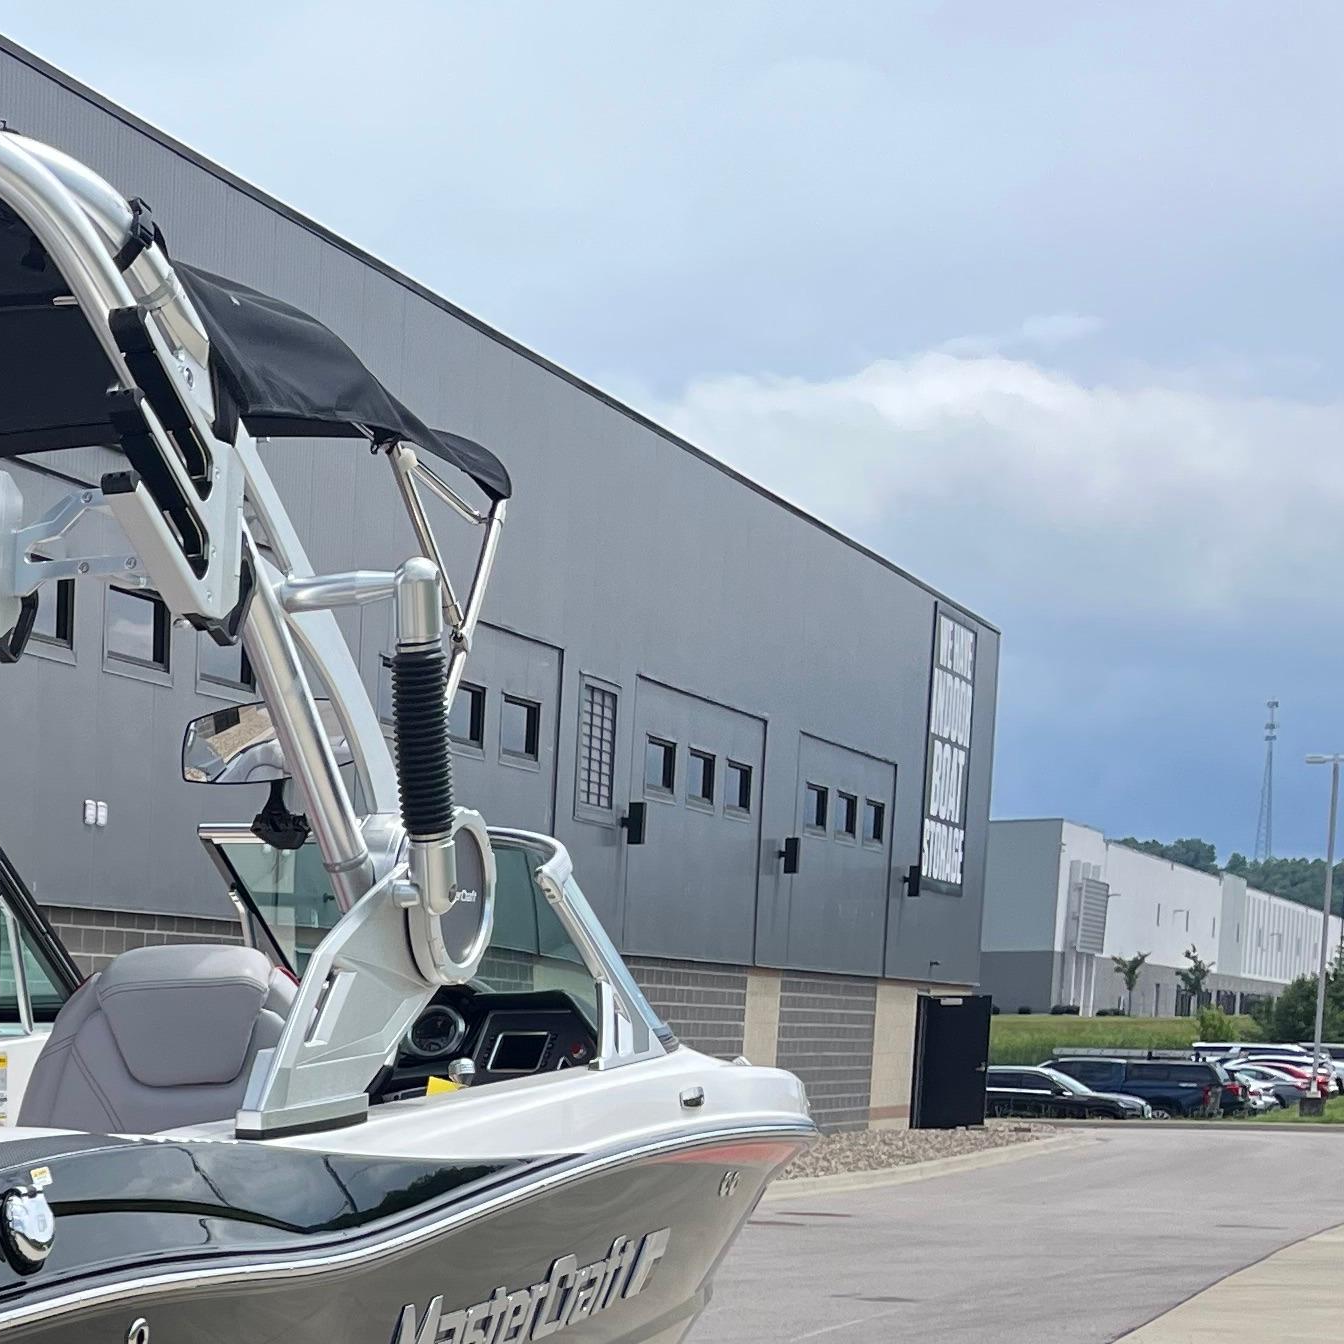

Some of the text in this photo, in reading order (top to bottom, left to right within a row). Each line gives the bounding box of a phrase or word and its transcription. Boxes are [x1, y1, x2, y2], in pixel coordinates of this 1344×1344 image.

[939, 615, 974, 681] WE HAVE
[930, 667, 973, 749] INDOOR
[929, 739, 966, 824] BOAT
[921, 817, 965, 885] STORAGE
